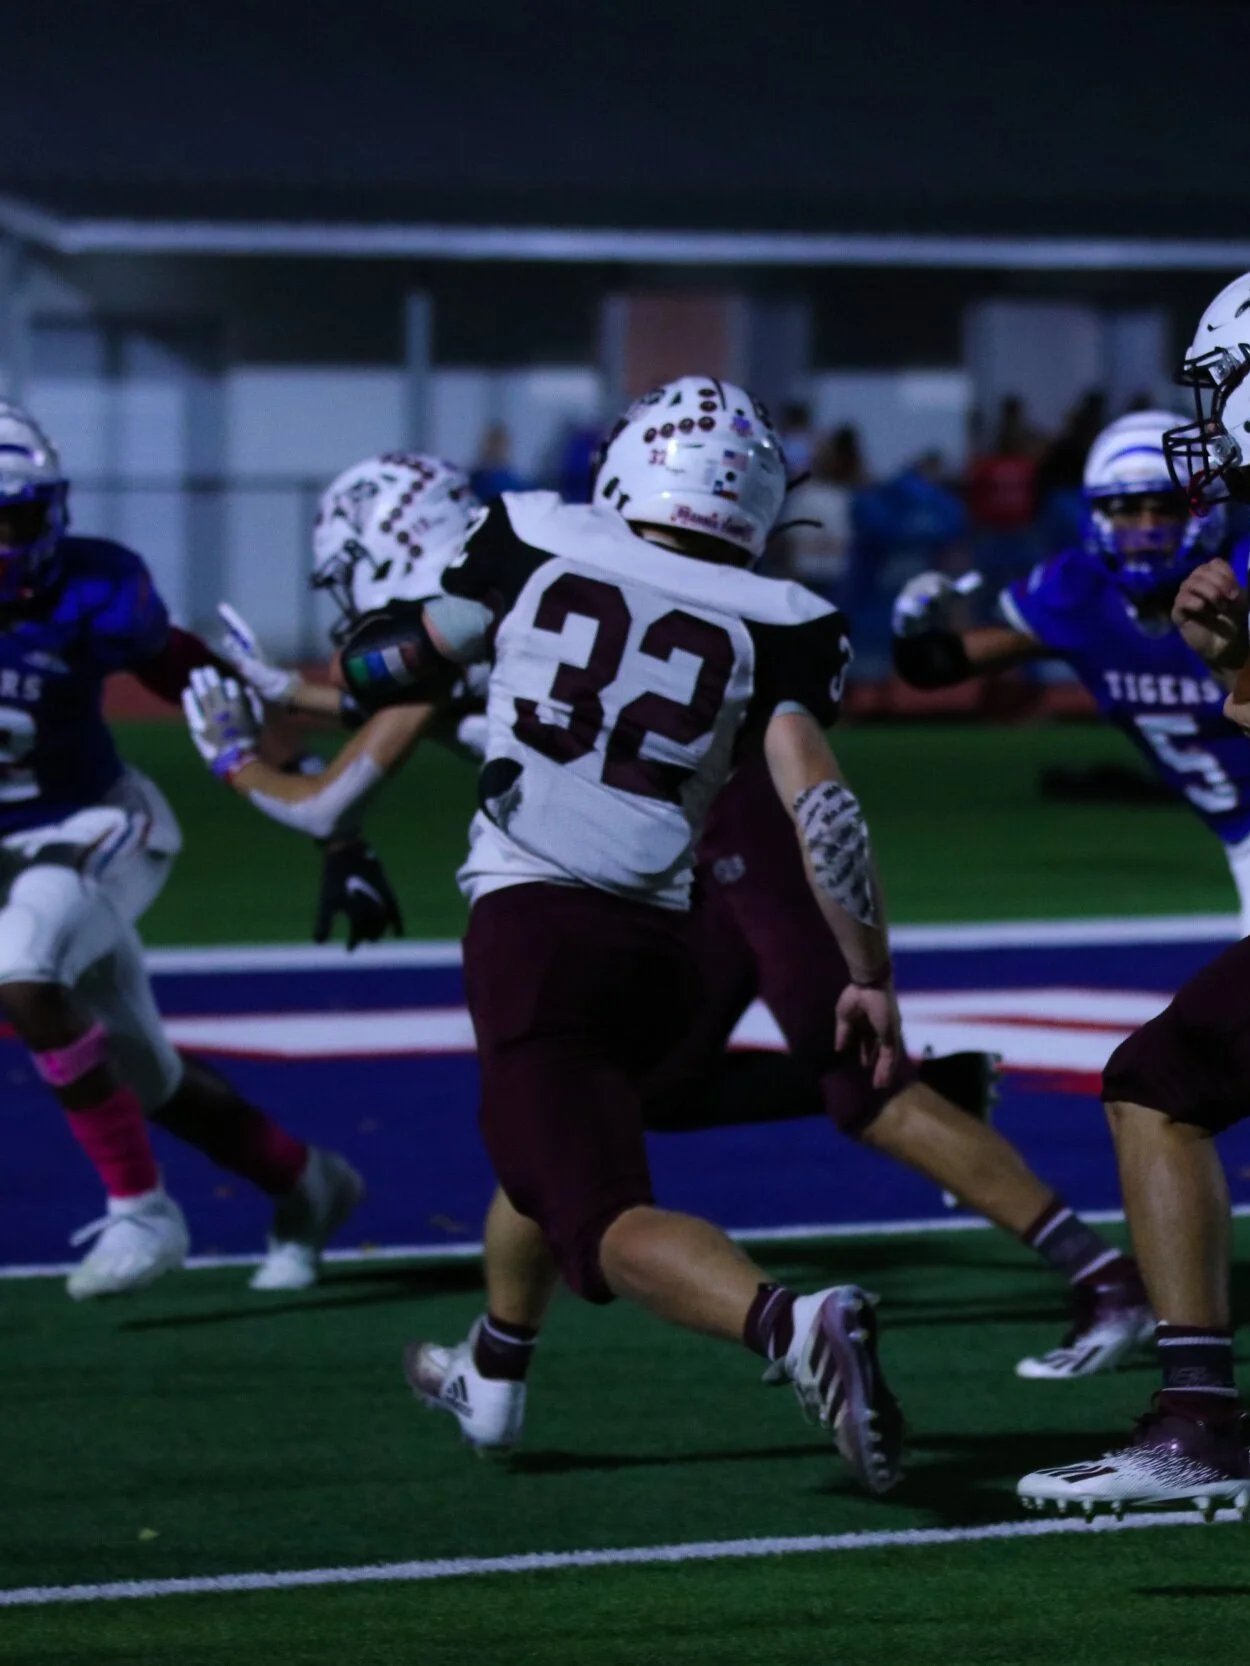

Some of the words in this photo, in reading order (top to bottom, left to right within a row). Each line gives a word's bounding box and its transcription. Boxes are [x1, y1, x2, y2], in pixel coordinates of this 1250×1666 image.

[513, 573, 735, 801] 32
[1102, 669, 1224, 706] TIGERS
[1133, 711, 1241, 815] 5
